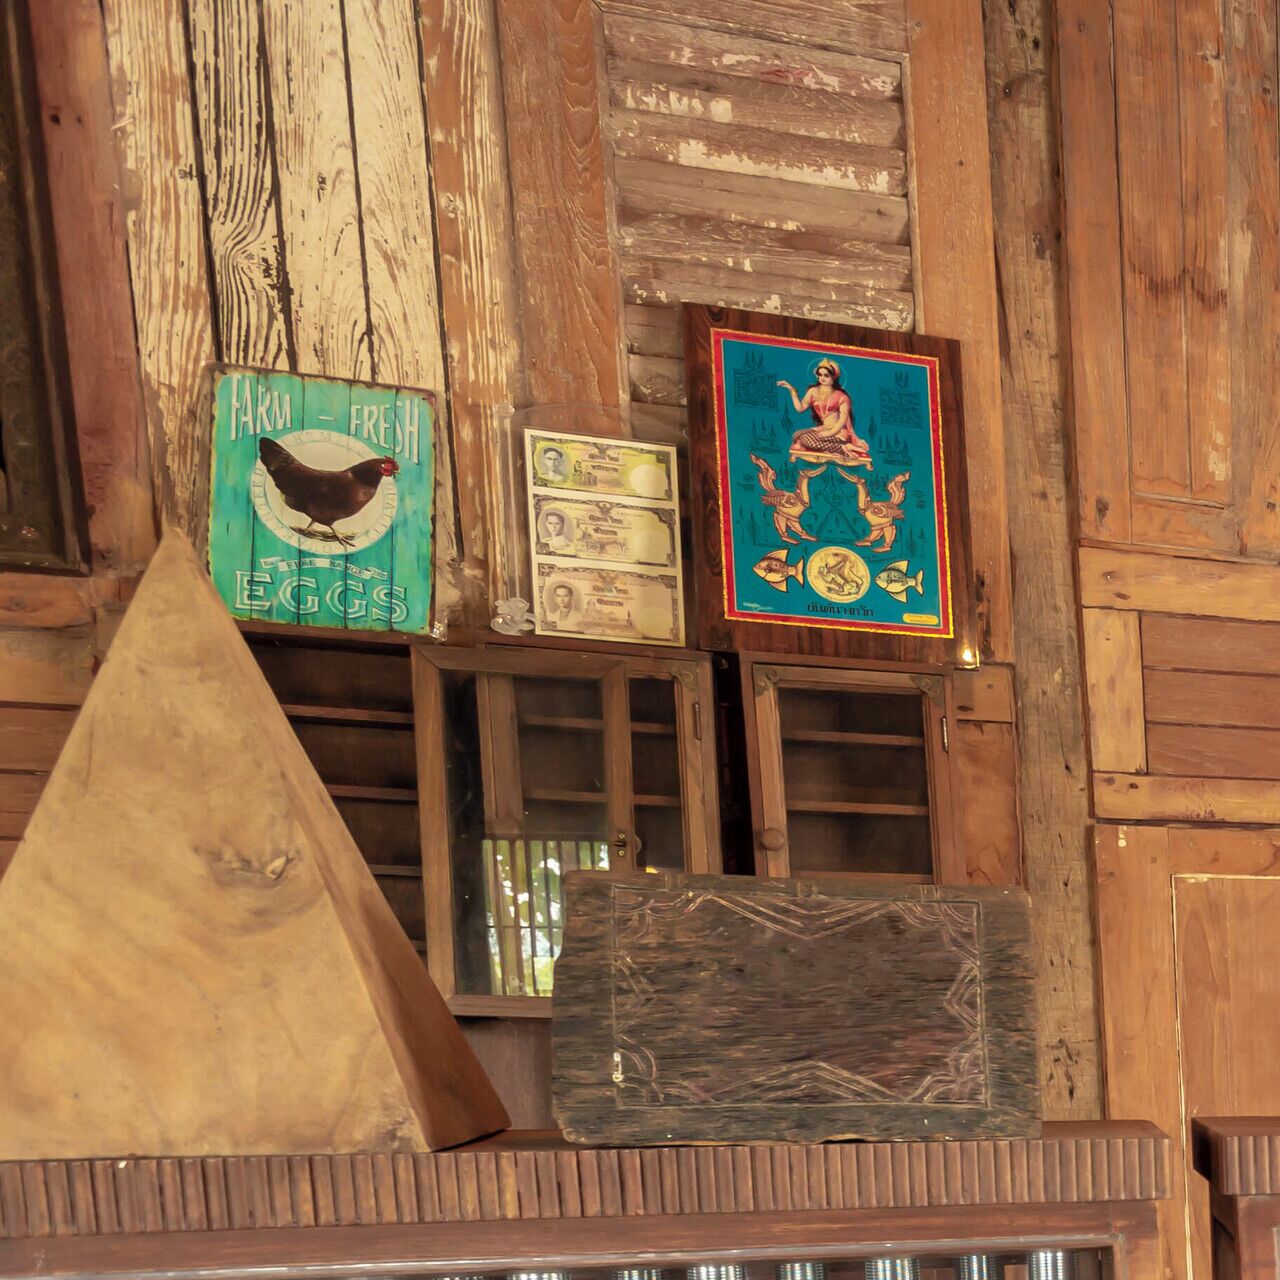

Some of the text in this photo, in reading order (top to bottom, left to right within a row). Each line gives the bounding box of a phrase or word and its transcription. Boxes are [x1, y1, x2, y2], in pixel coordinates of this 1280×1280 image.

[230, 375, 292, 441] FARM
[350, 397, 420, 465] FRESH
[329, 560, 365, 577] RANGE
[235, 570, 409, 623] EGGS
